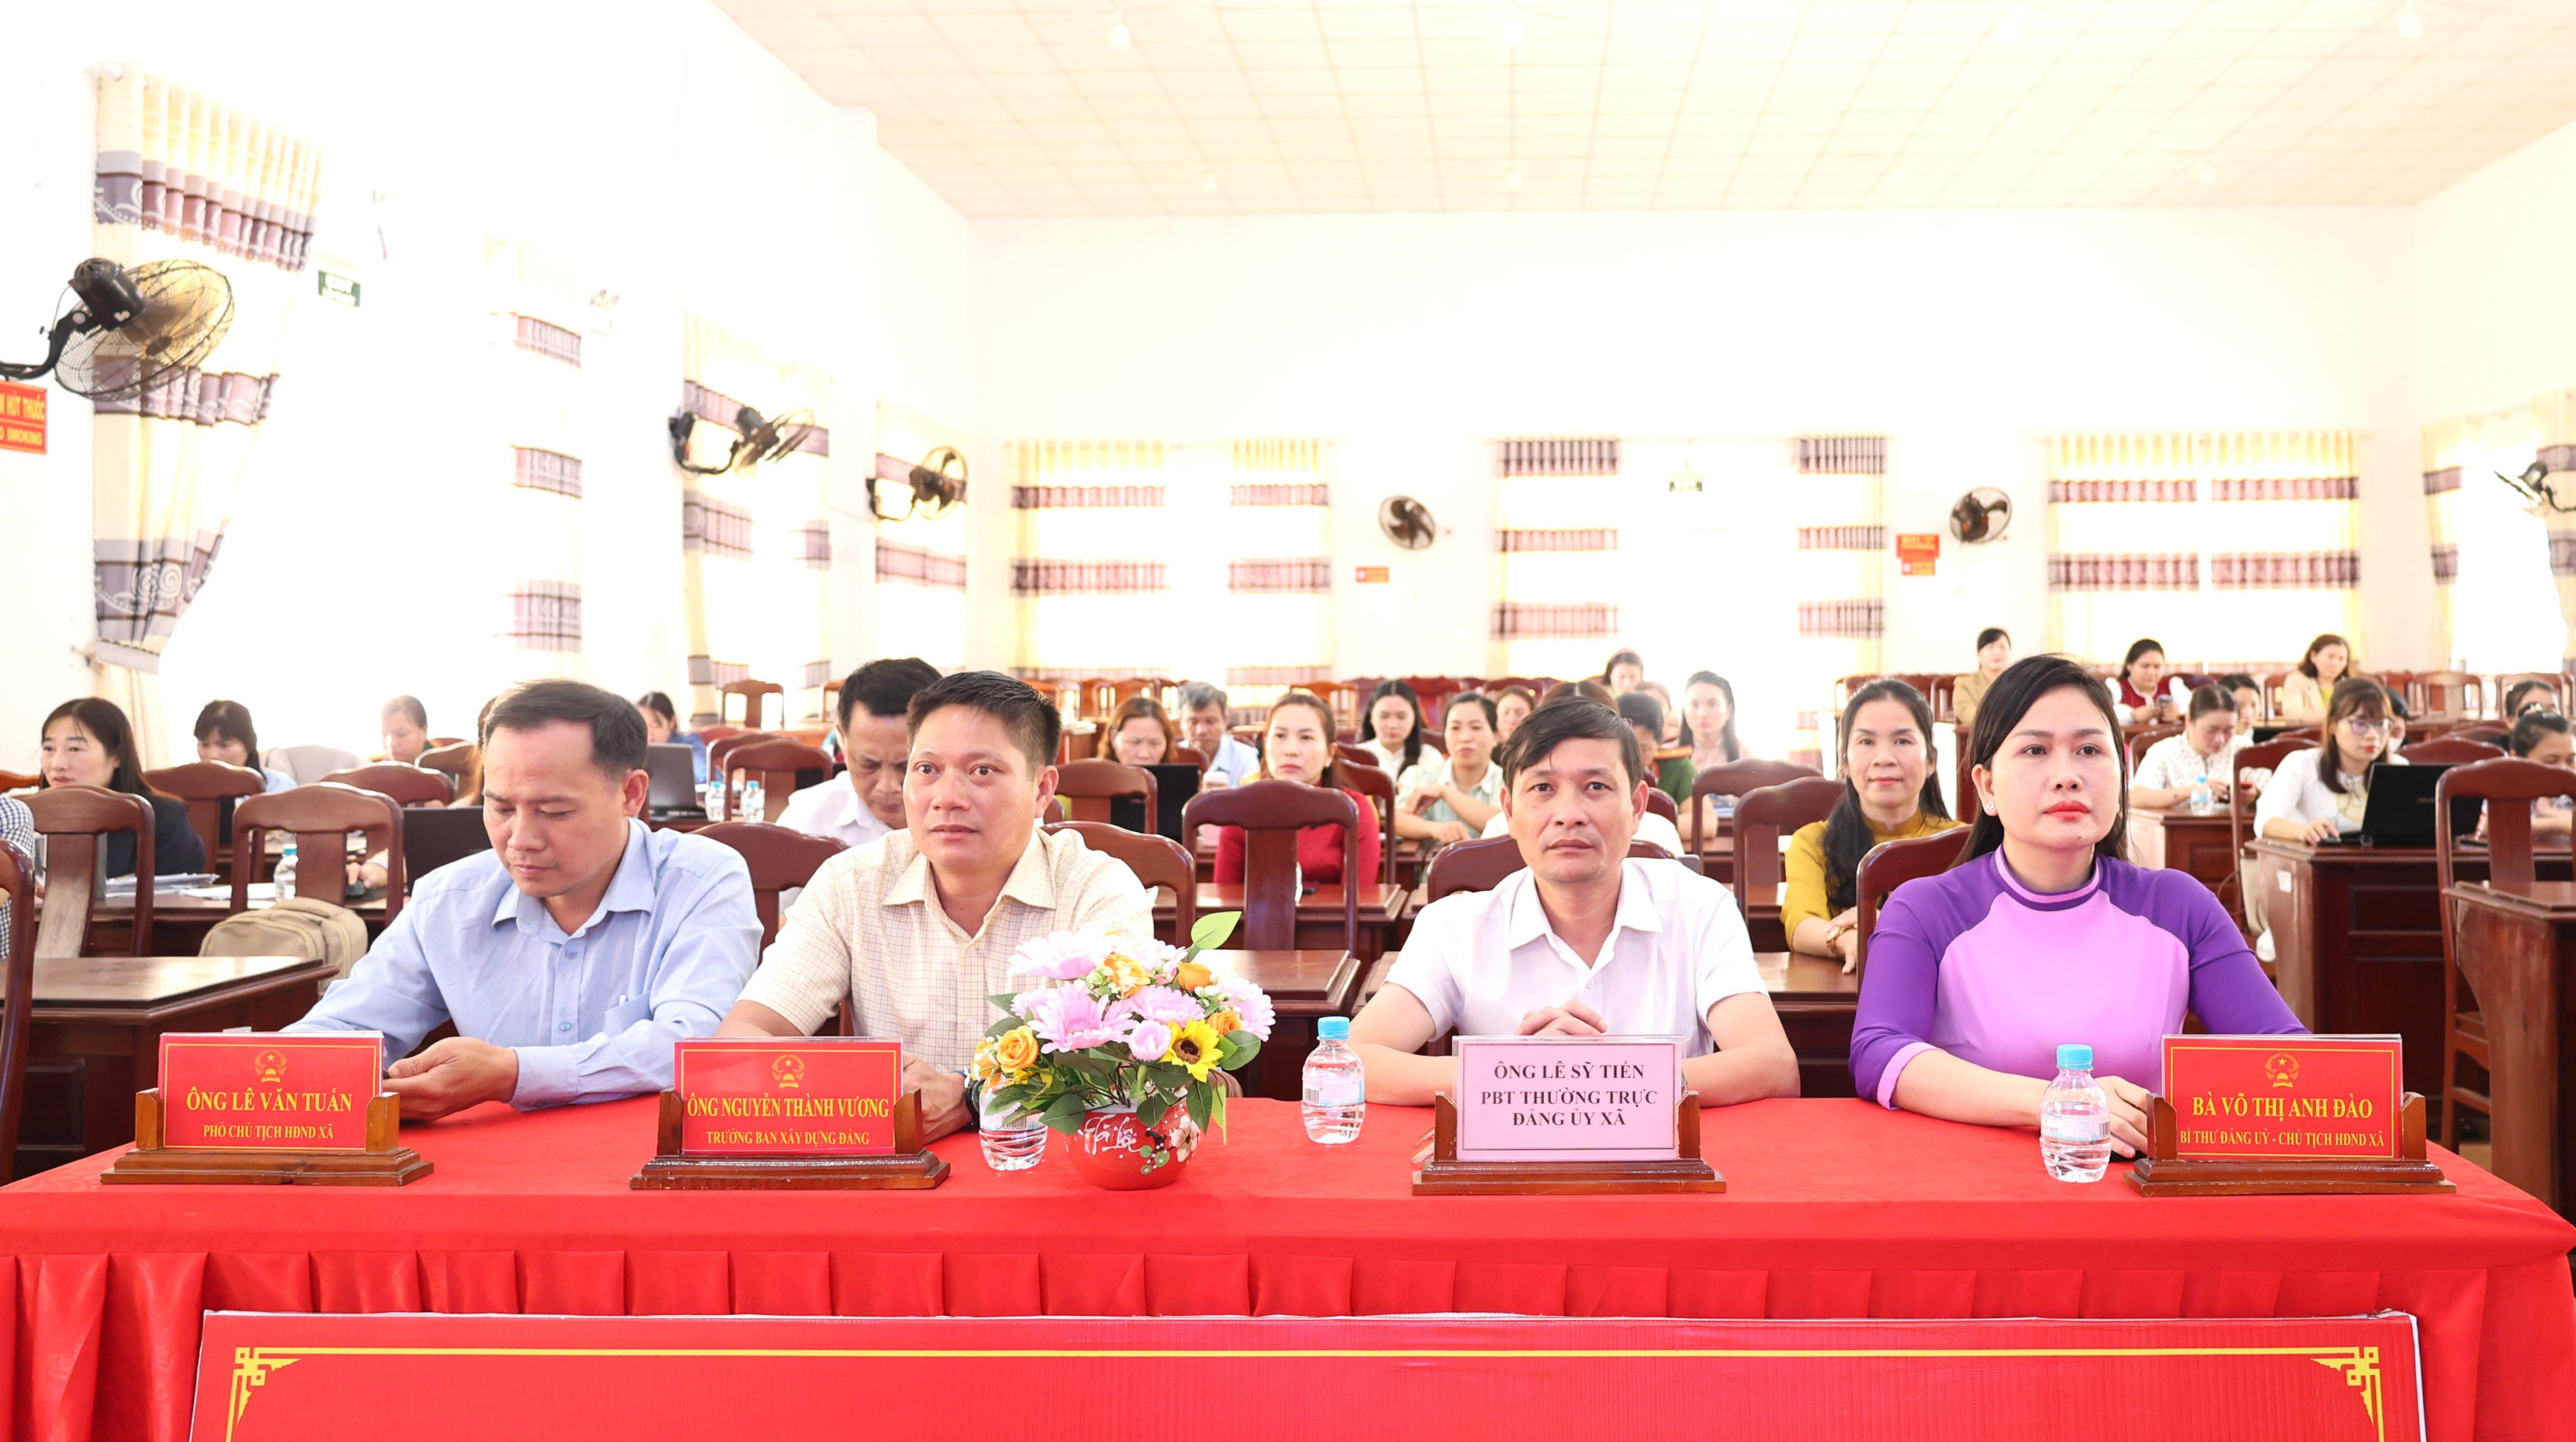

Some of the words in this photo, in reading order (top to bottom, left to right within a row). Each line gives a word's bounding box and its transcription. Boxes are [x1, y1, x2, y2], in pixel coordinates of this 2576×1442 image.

[7, 390, 21, 417] HÚT
[22, 393, 46, 423] THUỐC
[7, 427, 43, 446] SMOKING
[1493, 1061, 1535, 1079] ÔNG
[1542, 1061, 1565, 1079] LÊ
[1571, 1061, 1595, 1079] SỸ
[1600, 1060, 1644, 1079] TIẾN
[185, 1086, 228, 1110] ÔNG
[231, 1086, 256, 1110] LÊ
[259, 1087, 299, 1111] VĂN
[301, 1087, 353, 1112] TUẤN
[687, 1092, 719, 1116] ÔNG
[721, 1092, 781, 1116] NGUYỄN
[783, 1092, 834, 1117] THÀNH
[837, 1095, 890, 1118] VƯƠNG
[1481, 1091, 1516, 1105] PBT
[1520, 1086, 1601, 1105] THƯỜNG
[1606, 1088, 1657, 1108] TRỰC
[2192, 1091, 2217, 1116] BÀ
[2221, 1092, 2248, 1116] VÕ
[2252, 1098, 2284, 1122] THỊ
[2288, 1098, 2329, 1117] ANH
[2332, 1092, 2372, 1119] ĐÀO
[1512, 1108, 1564, 1126] ĐẢNG
[1571, 1108, 1595, 1126] ỦY
[1601, 1108, 1625, 1125] XÃ
[203, 1121, 227, 1138] PHÓ
[228, 1121, 252, 1138] CHỦ
[254, 1125, 283, 1141] TỊCH
[284, 1125, 317, 1139] HĐND
[318, 1123, 334, 1140] XÃ
[707, 1128, 753, 1144] TRƯỞNG
[755, 1131, 777, 1144] BAN
[780, 1128, 802, 1145] XÂY
[805, 1130, 836, 1147] DỰNG
[839, 1129, 870, 1145] ĐẢNG
[2180, 1126, 2191, 1144] BÍ
[2193, 1129, 2219, 1144] THƯ
[2221, 1127, 2252, 1145] ĐẢNG
[2254, 1128, 2270, 1145] UỶ
[2278, 1129, 2302, 1146] CHỦ
[2305, 1132, 2332, 1149] TỊCH
[2336, 1133, 2367, 1147] HĐND
[2369, 1130, 2385, 1147] XÃ
